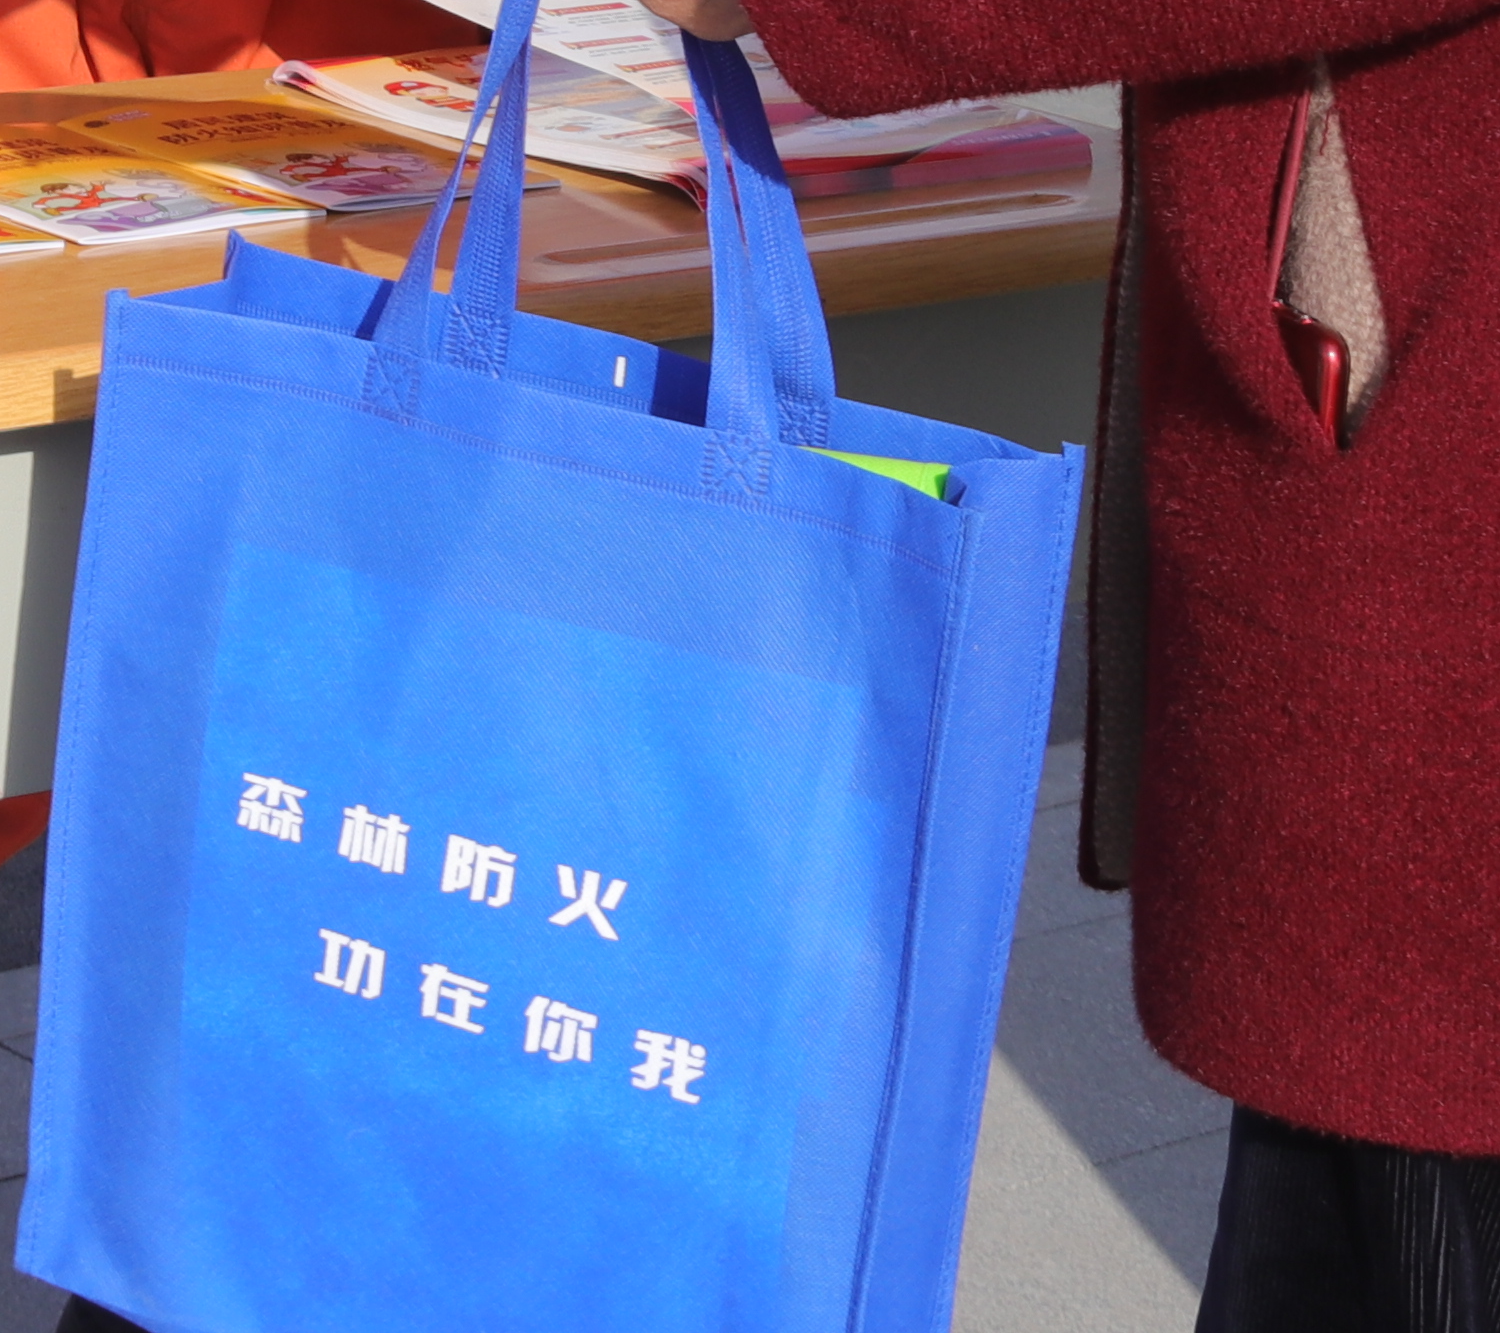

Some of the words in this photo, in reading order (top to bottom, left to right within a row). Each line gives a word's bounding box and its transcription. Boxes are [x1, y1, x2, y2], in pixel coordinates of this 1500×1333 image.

[236, 773, 630, 942] 森林防火
[313, 927, 708, 1105] 功在你我
